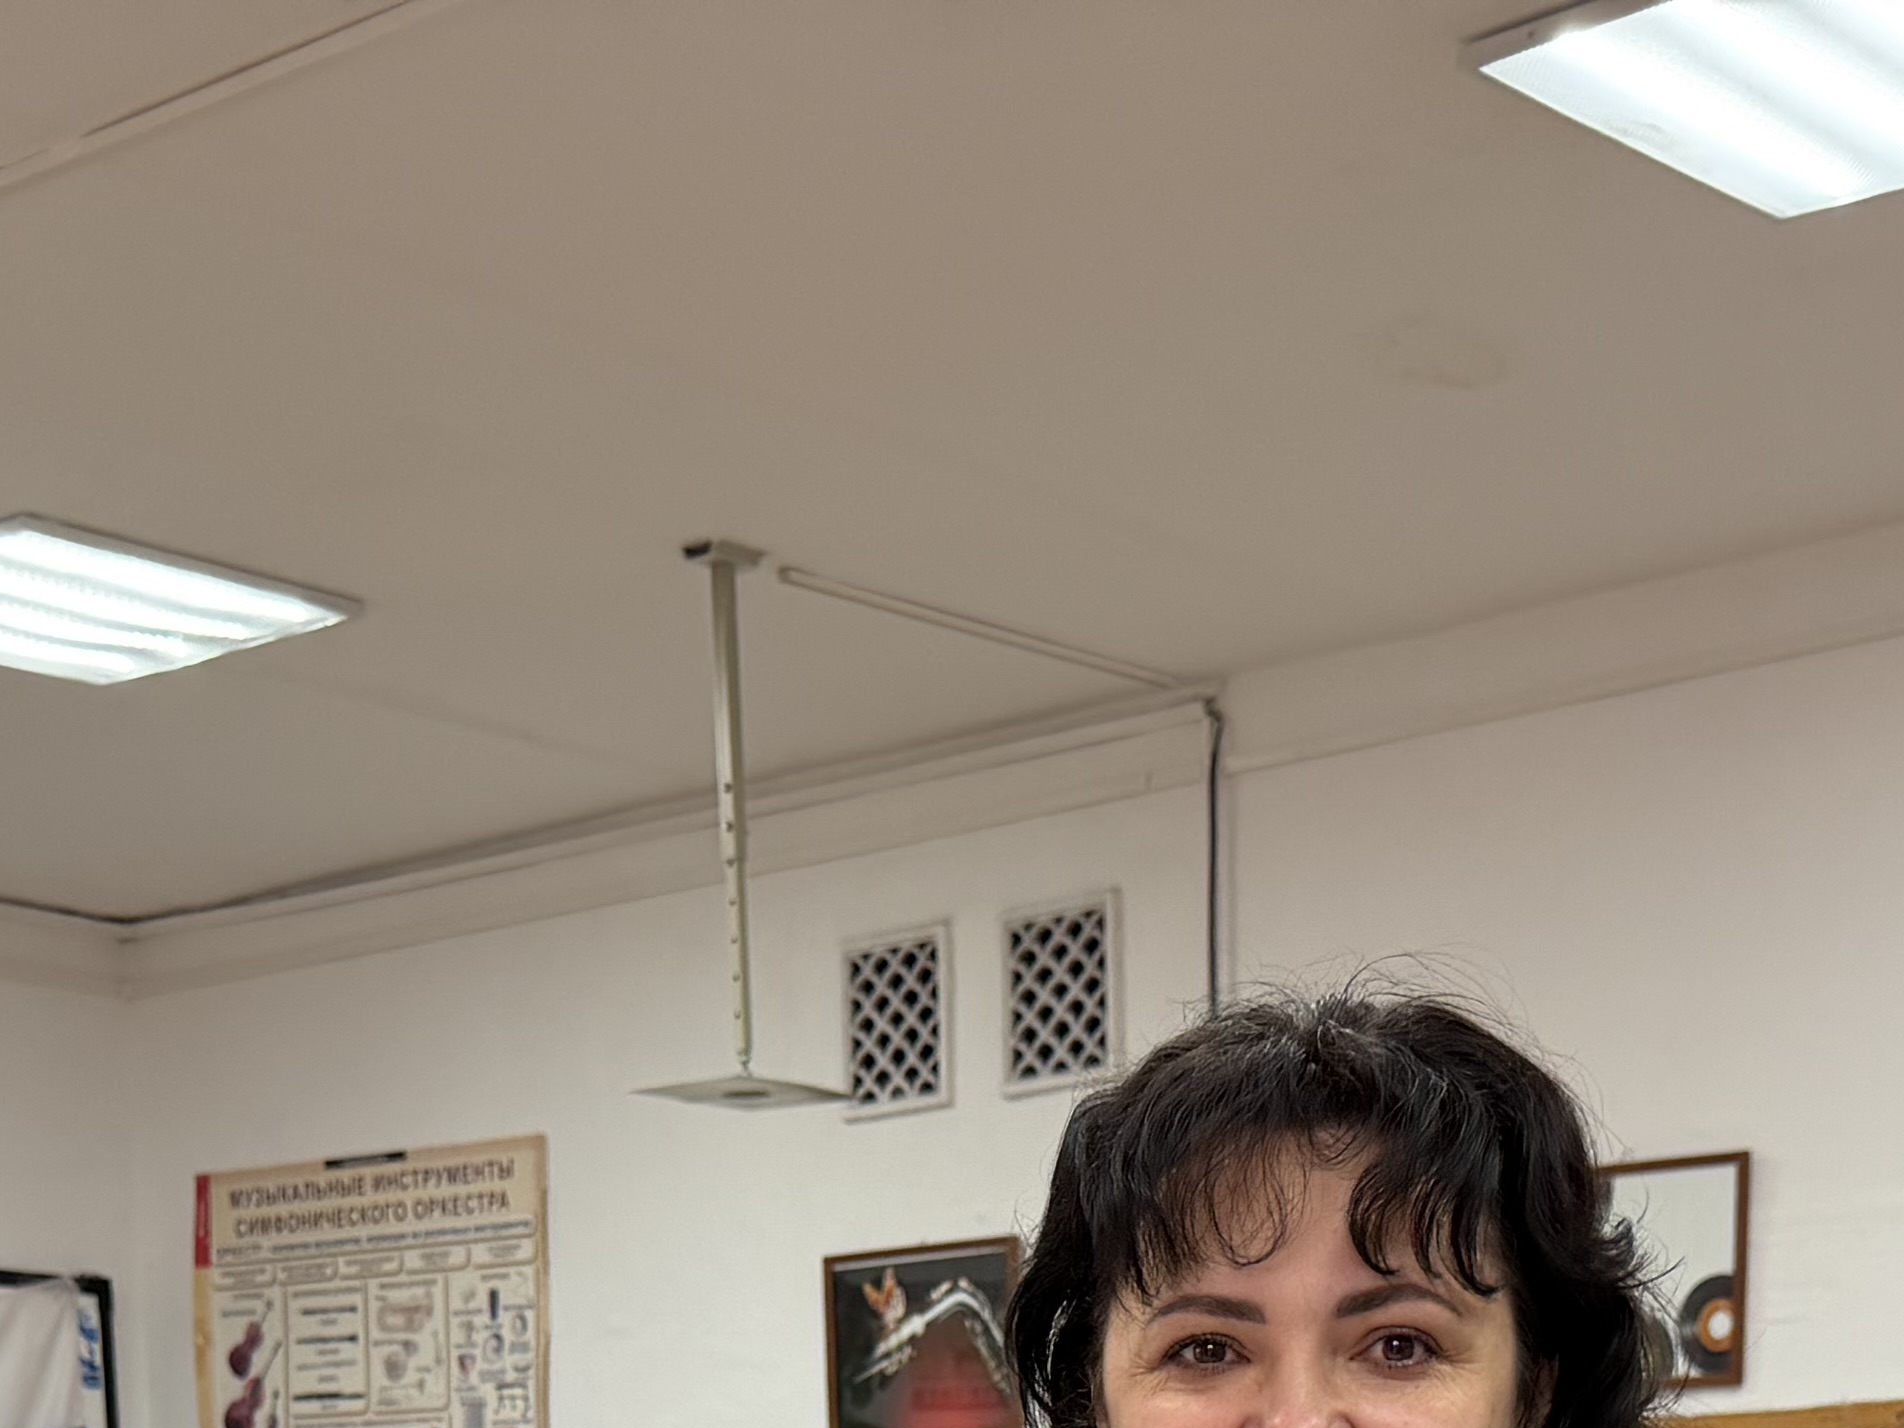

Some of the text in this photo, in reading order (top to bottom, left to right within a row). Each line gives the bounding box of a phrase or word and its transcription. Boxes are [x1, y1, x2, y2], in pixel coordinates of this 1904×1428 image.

[230, 1158, 515, 1209] МУЗЫКАЛЬНЫЕ ИНСТРУМЕНТЫ
[235, 1200, 409, 1238] СИМФОНИЧЕСКОГО
[412, 1189, 511, 1220] ОРКЕСТРА
